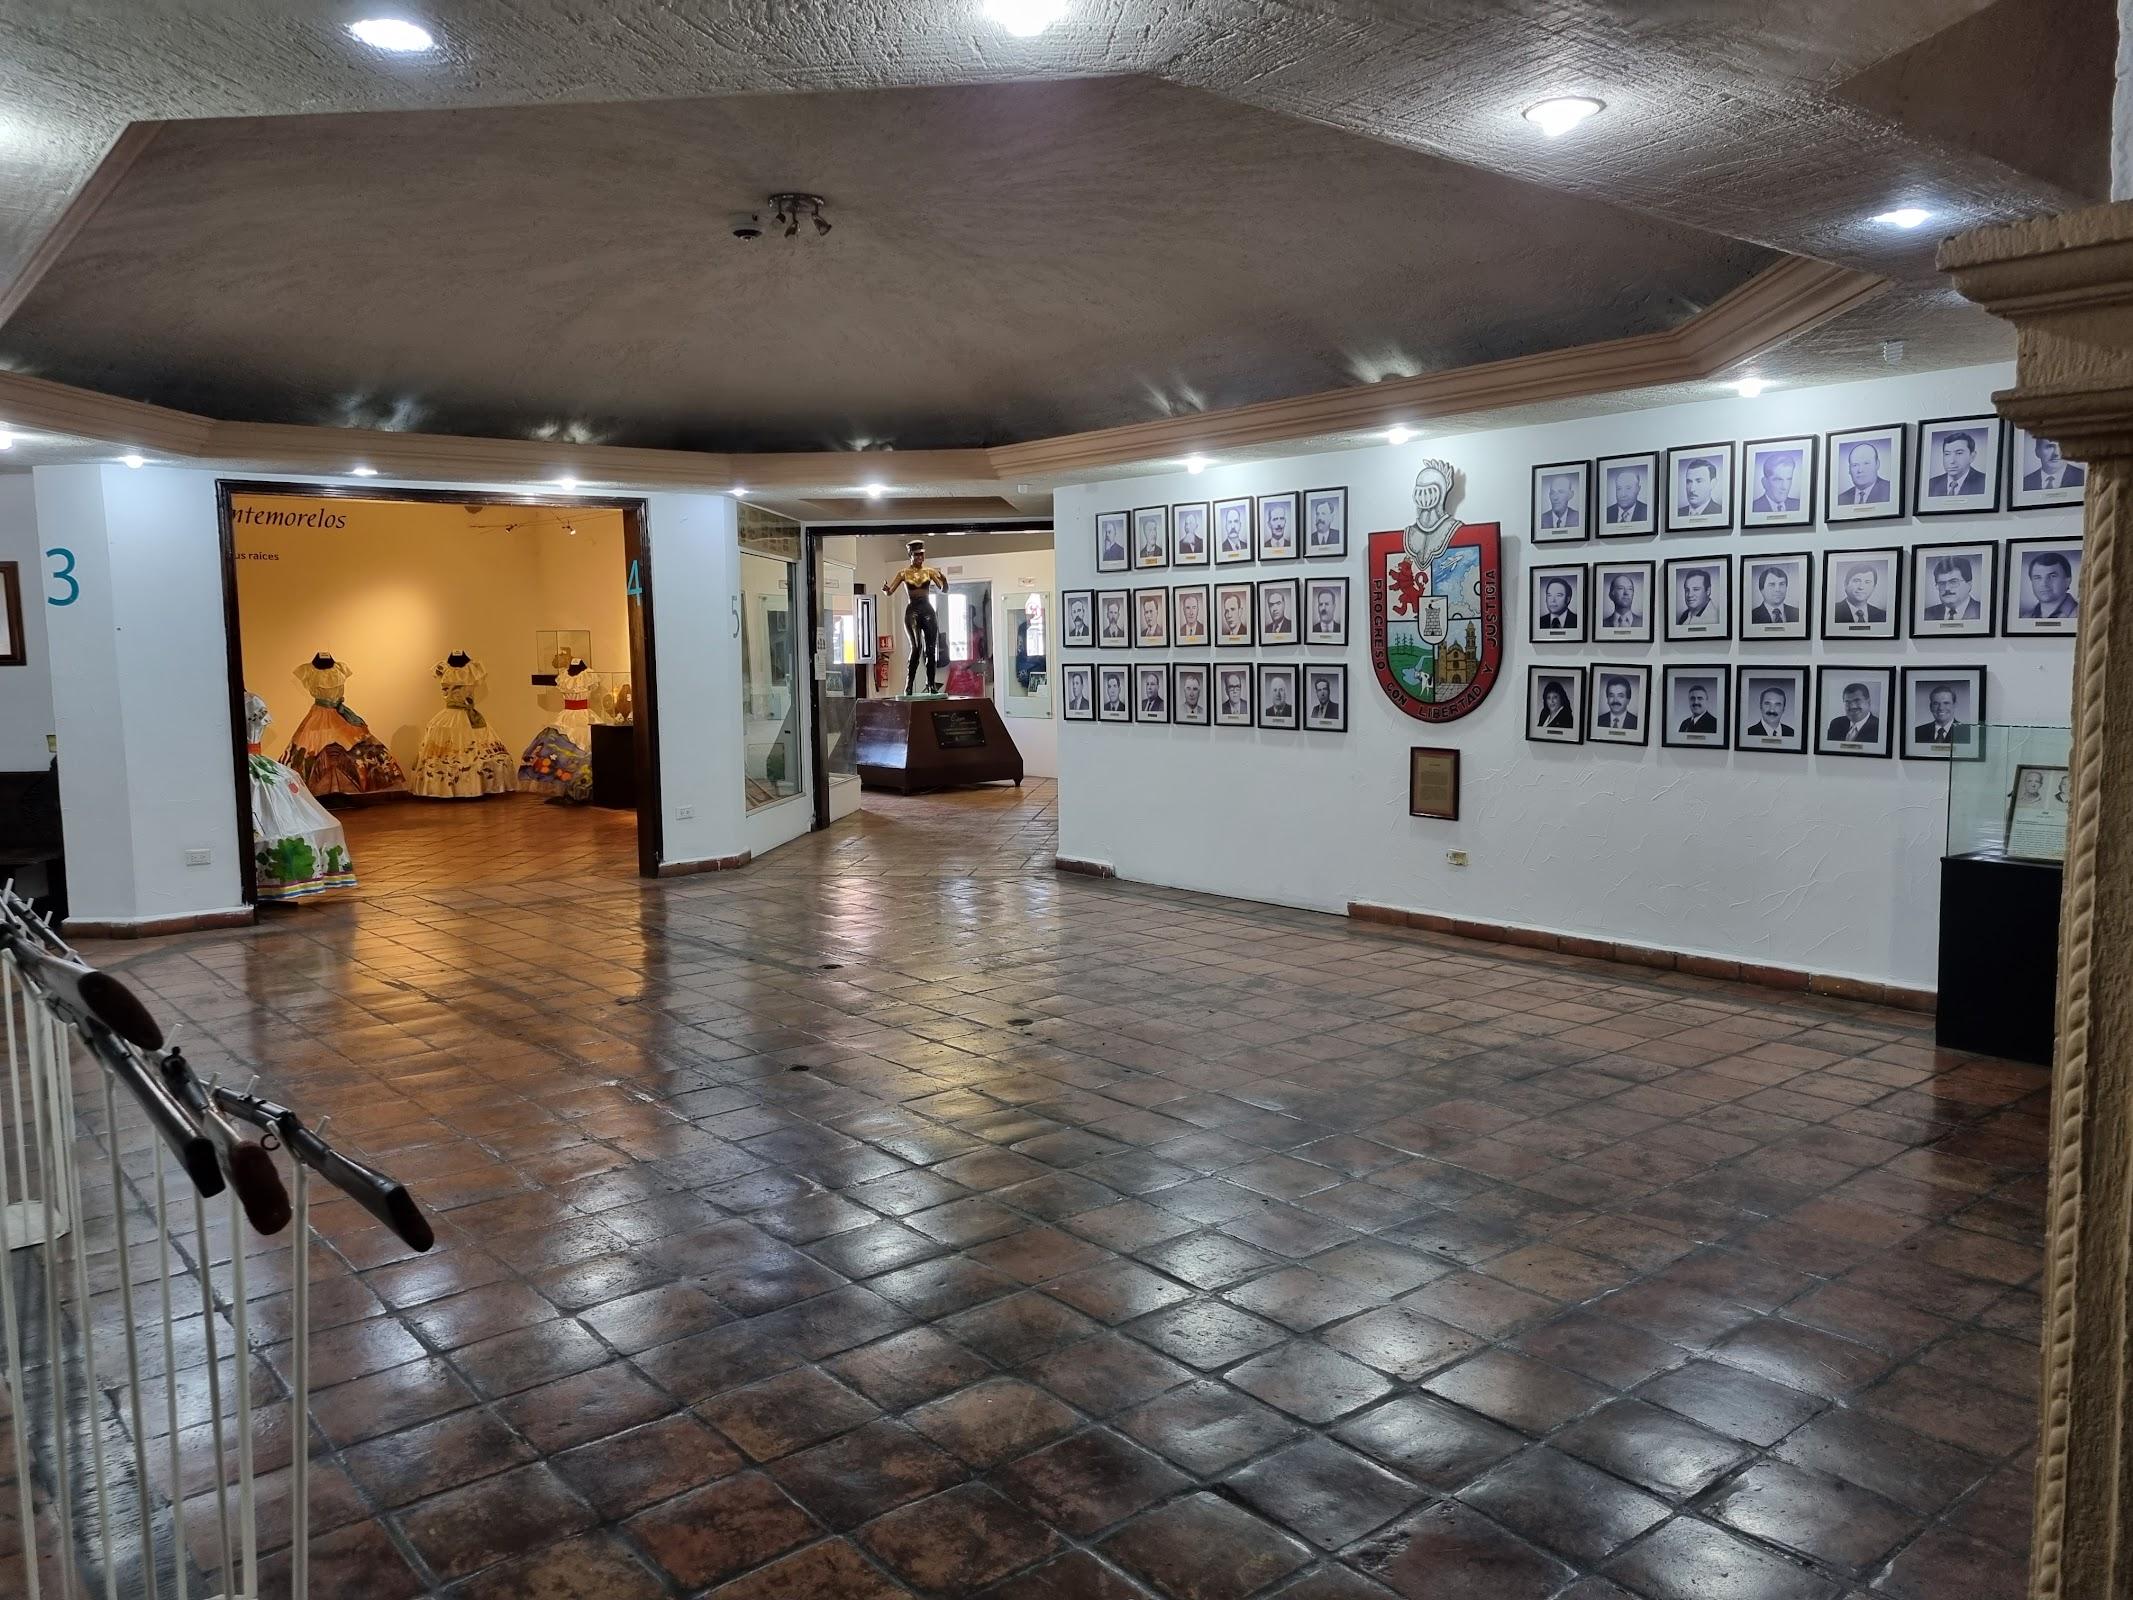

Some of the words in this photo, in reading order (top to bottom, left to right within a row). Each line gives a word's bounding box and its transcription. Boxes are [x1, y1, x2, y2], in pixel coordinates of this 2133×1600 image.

[46, 547, 80, 607] 3
[627, 559, 643, 607] 4
[731, 595, 740, 639] 5
[1373, 578, 1386, 671] PROGRESO
[1485, 568, 1497, 649] JUSTICIA
[1482, 662, 1494, 676] Y
[1386, 682, 1408, 706] CON
[1417, 684, 1483, 719] LIBERTAD
